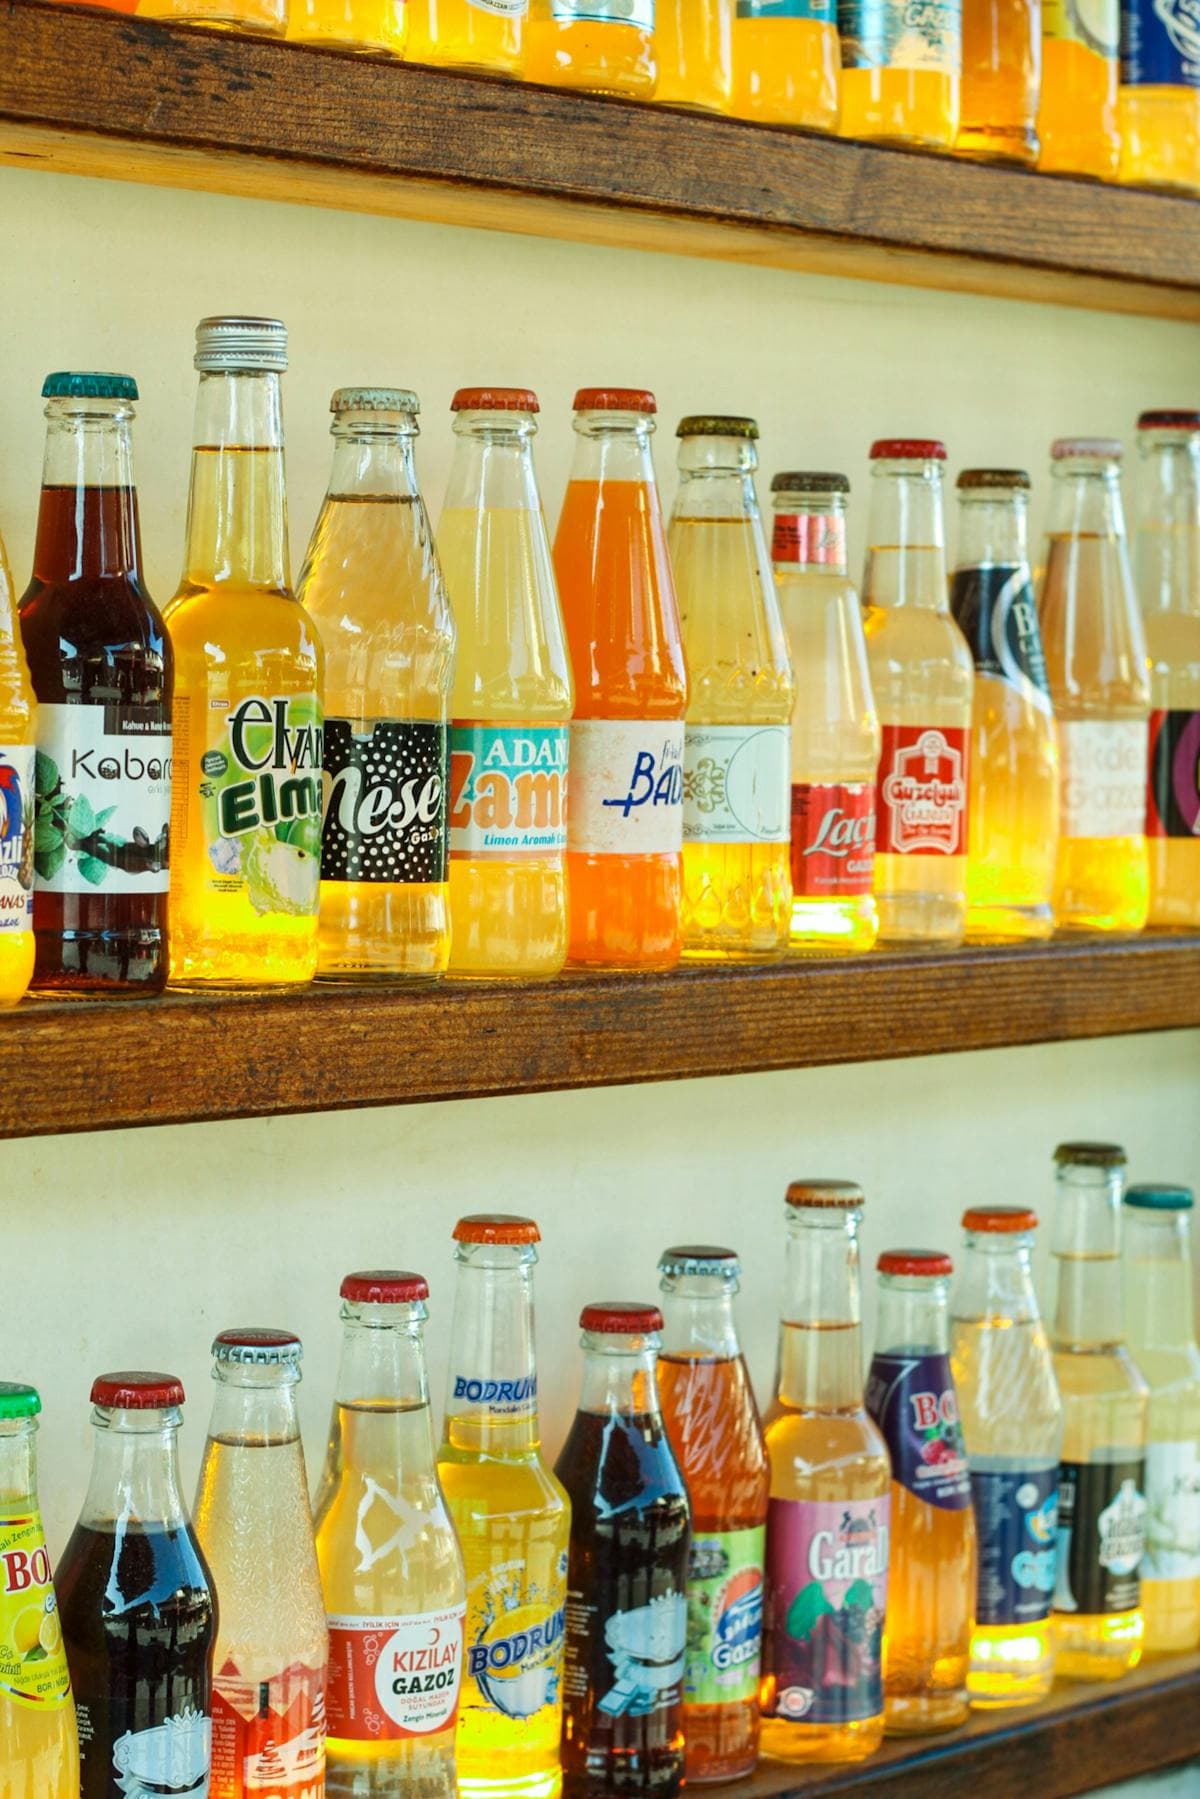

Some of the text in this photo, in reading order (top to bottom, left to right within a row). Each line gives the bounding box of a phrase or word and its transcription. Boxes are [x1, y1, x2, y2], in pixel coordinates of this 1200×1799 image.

[72, 748, 172, 780] Kabar
[450, 752, 568, 830] Zam
[484, 834, 516, 845] Limon
[2, 1544, 53, 1592] BO
[393, 1640, 458, 1673] KIZILAY
[392, 1667, 455, 1696] GAZOZ
